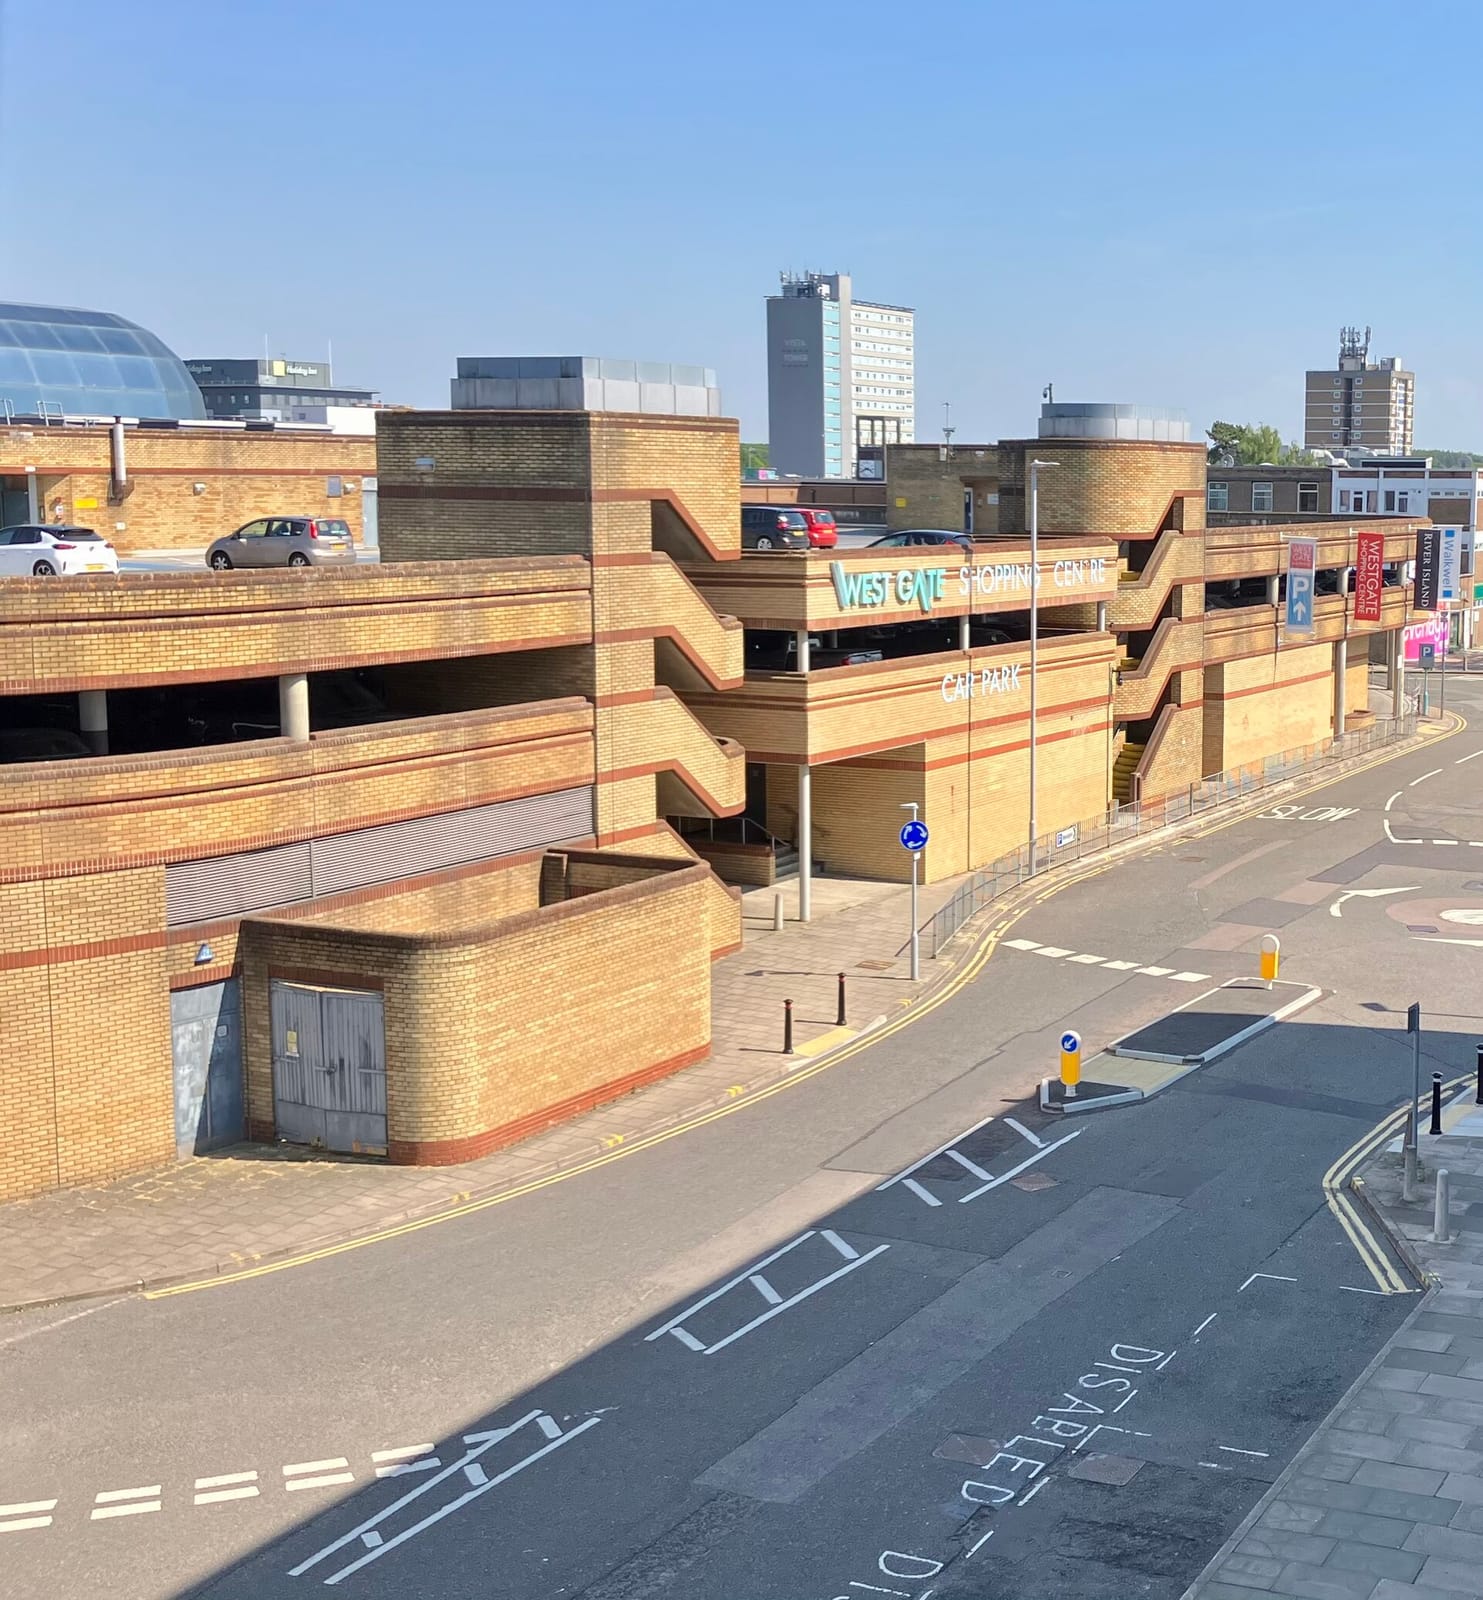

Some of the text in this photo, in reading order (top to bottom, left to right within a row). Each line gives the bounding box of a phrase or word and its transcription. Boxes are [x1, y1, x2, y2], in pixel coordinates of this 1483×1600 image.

[286, 363, 318, 376] Holiday Inn
[829, 560, 892, 608] WEST
[895, 568, 946, 613] GATE
[1054, 558, 1105, 588] CENRE
[1292, 576, 1309, 599] P
[1357, 539, 1369, 615] SHOPPING CENTRE
[1365, 540, 1381, 615] WESTGATE
[1421, 532, 1433, 607] RIVER ISLAND
[1422, 646, 1432, 657] P
[941, 663, 1022, 704] CAR PARK
[1255, 804, 1361, 822] SLOW
[960, 1343, 1165, 1504] DISABLED
[830, 1550, 944, 1600] DI
